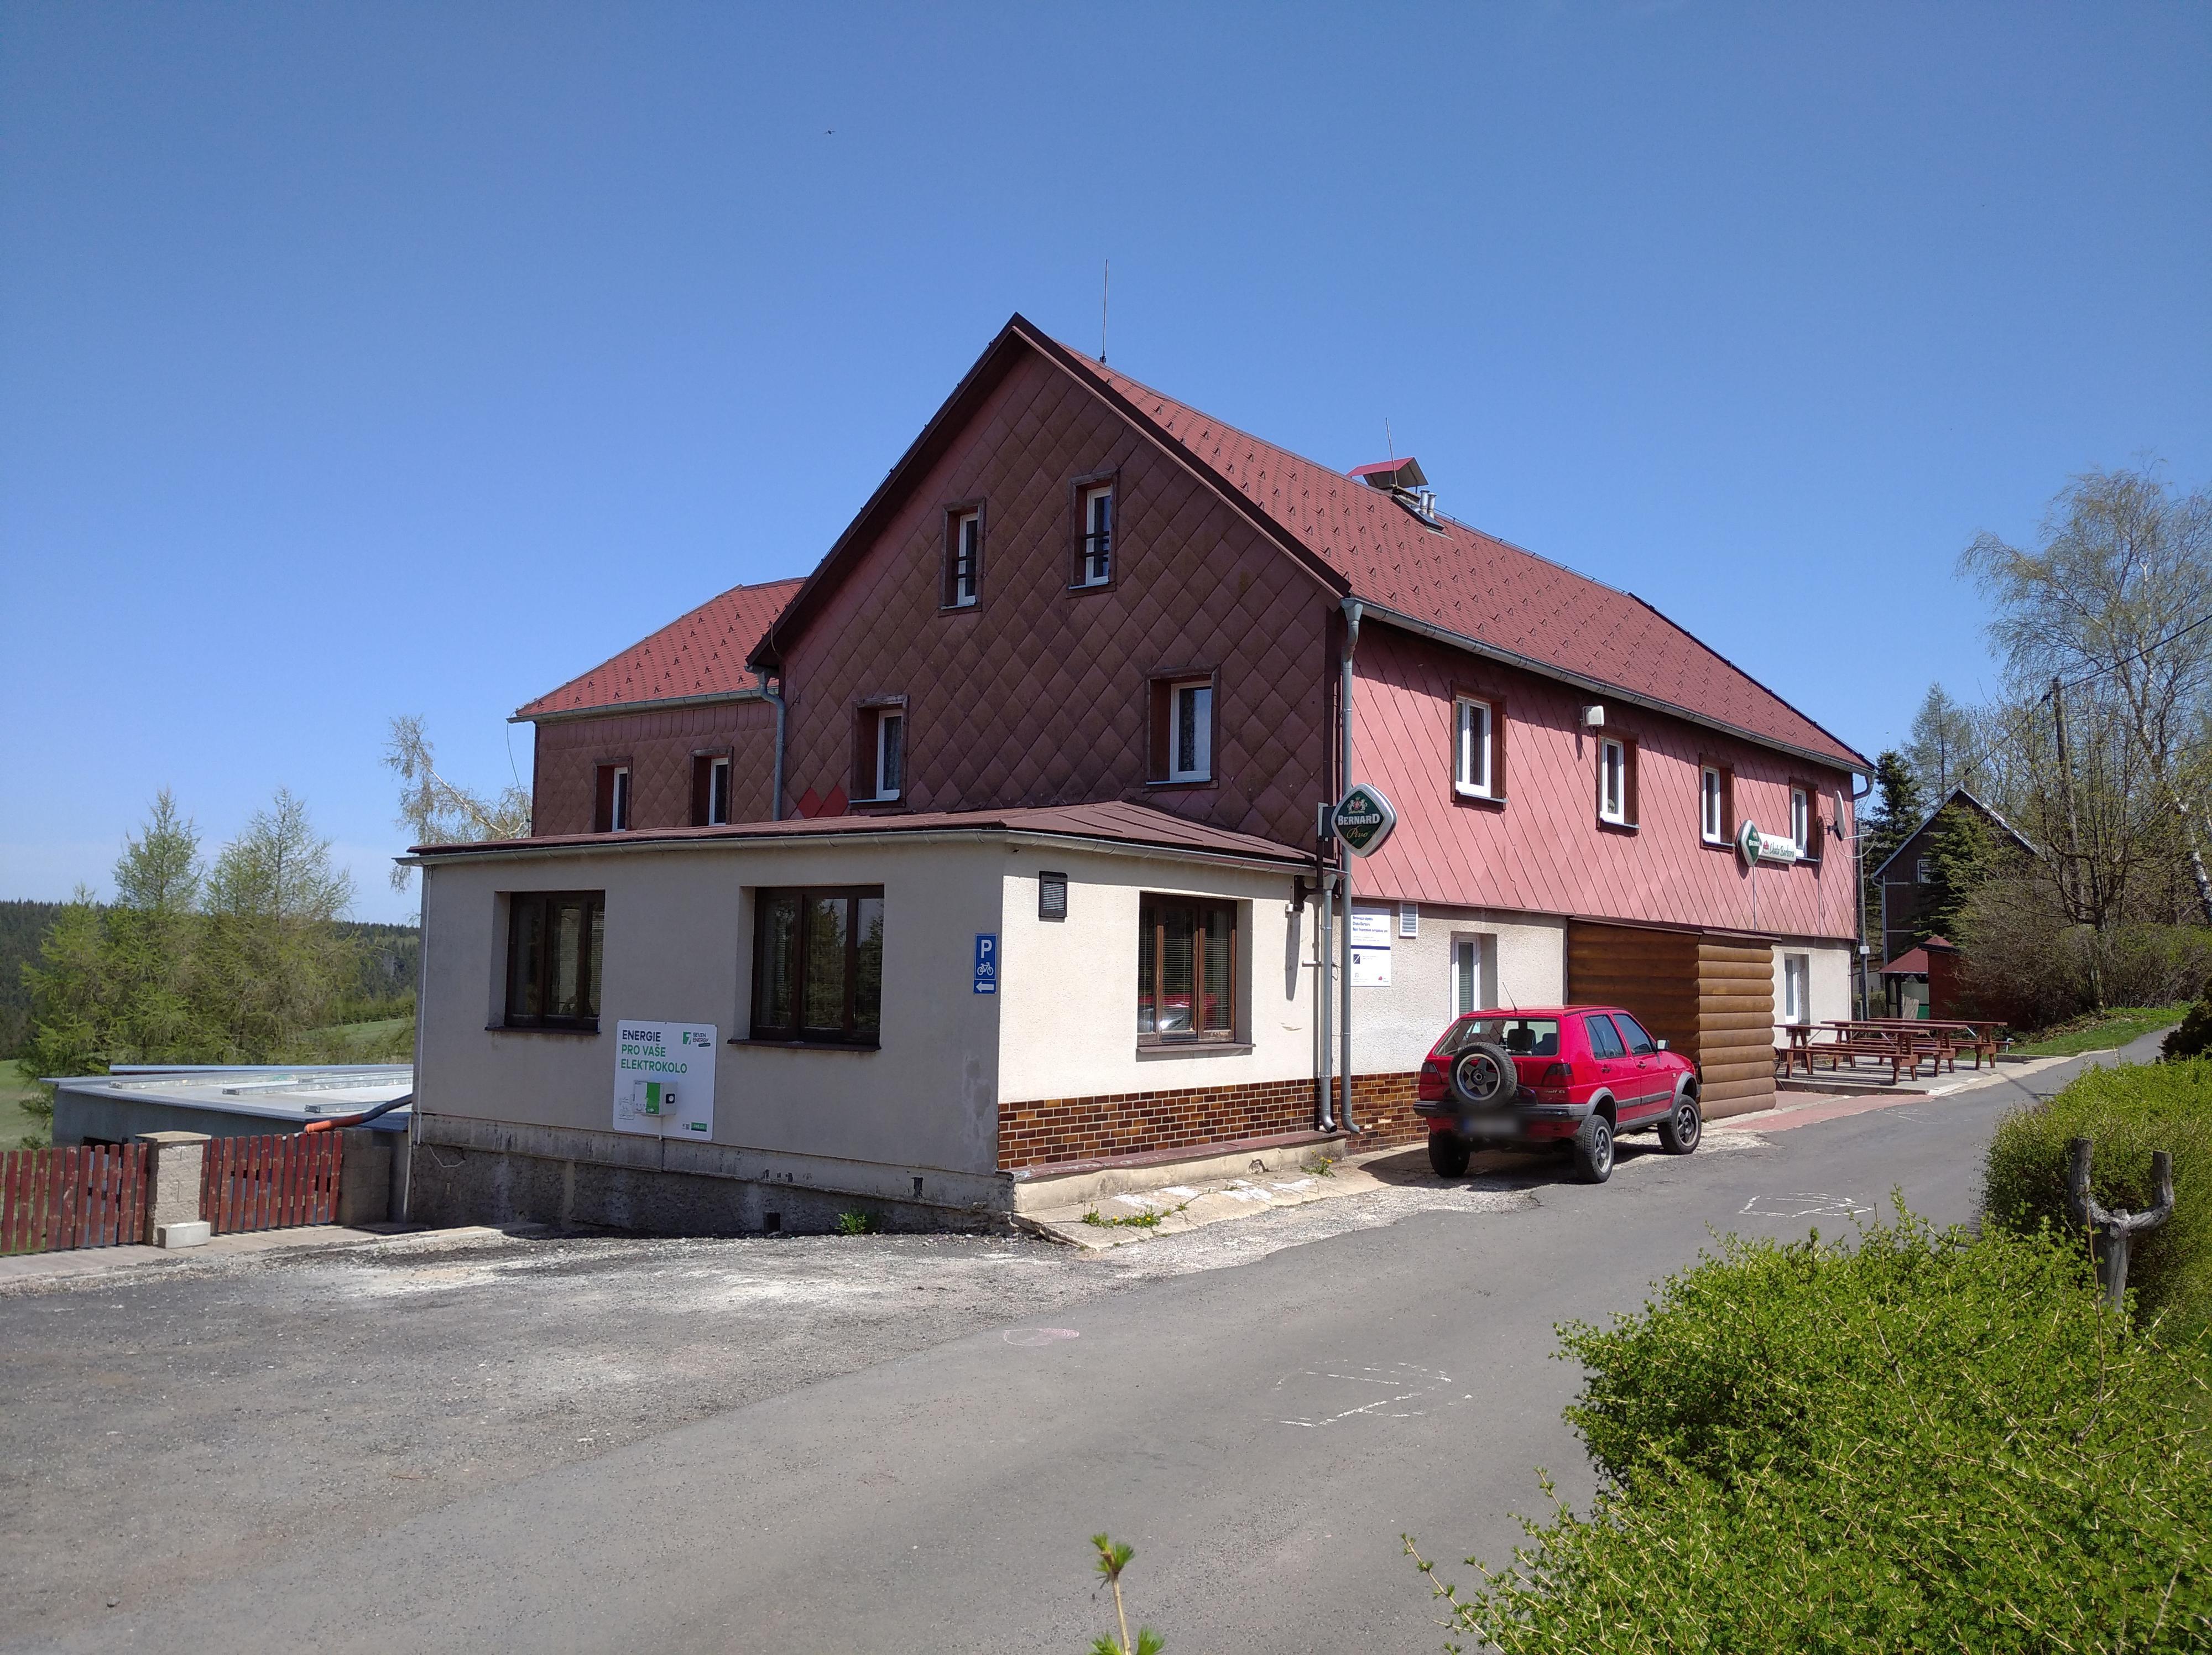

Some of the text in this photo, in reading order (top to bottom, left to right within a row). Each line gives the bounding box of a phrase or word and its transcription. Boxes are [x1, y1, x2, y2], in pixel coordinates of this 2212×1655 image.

[1338, 813, 1380, 826] BERNARD
[1347, 825, 1368, 838] Pivo
[980, 939, 992, 959] P
[622, 1029, 661, 1042] ENERGIE
[621, 1043, 666, 1057] PRO VAŠE
[620, 1059, 687, 1074] ELEKTROKOLO
